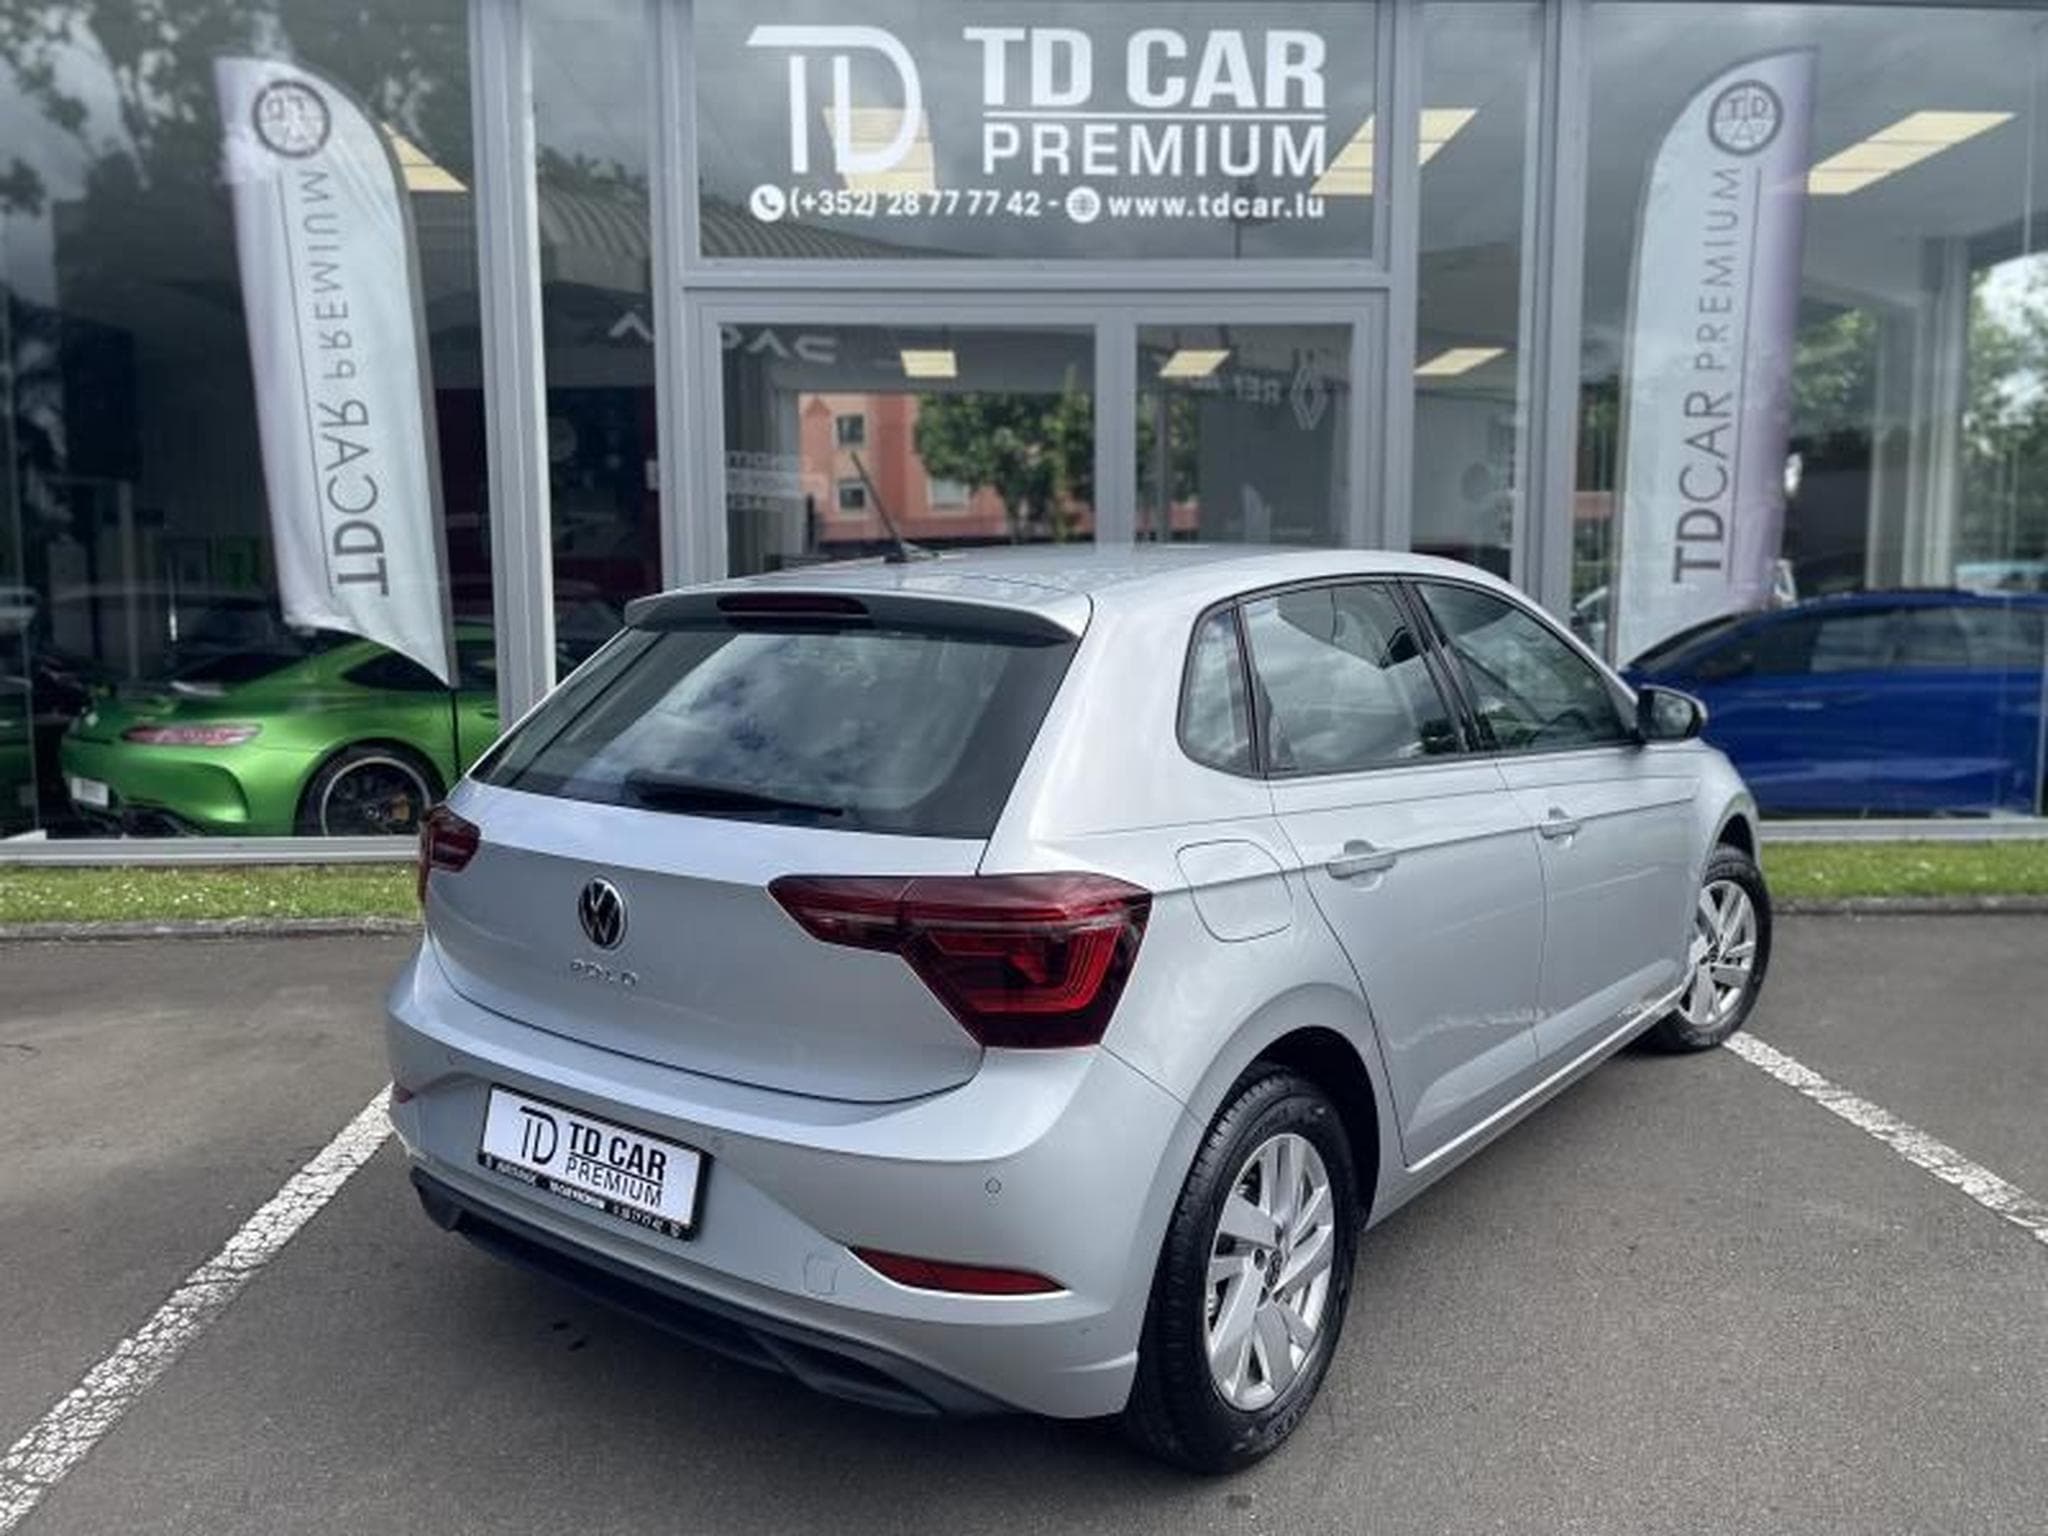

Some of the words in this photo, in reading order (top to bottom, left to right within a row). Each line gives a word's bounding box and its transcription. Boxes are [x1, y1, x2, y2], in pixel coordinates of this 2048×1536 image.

[963, 27, 1093, 107] TD
[1126, 28, 1326, 108] CAR
[983, 124, 1326, 176] PREMIUM
[790, 187, 878, 218] (+352)
[886, 190, 921, 217] 28
[926, 190, 961, 217] 77
[966, 190, 1001, 217] 77
[1005, 190, 1041, 217] 42
[1107, 191, 1326, 218] www.tdcar.lu
[1694, 166, 1741, 372] PREMIUM
[1673, 390, 1733, 584] TDCAR
[568, 1122, 601, 1158] TD
[608, 1137, 667, 1181] CAR
[565, 1157, 664, 1208] PREMIUM
